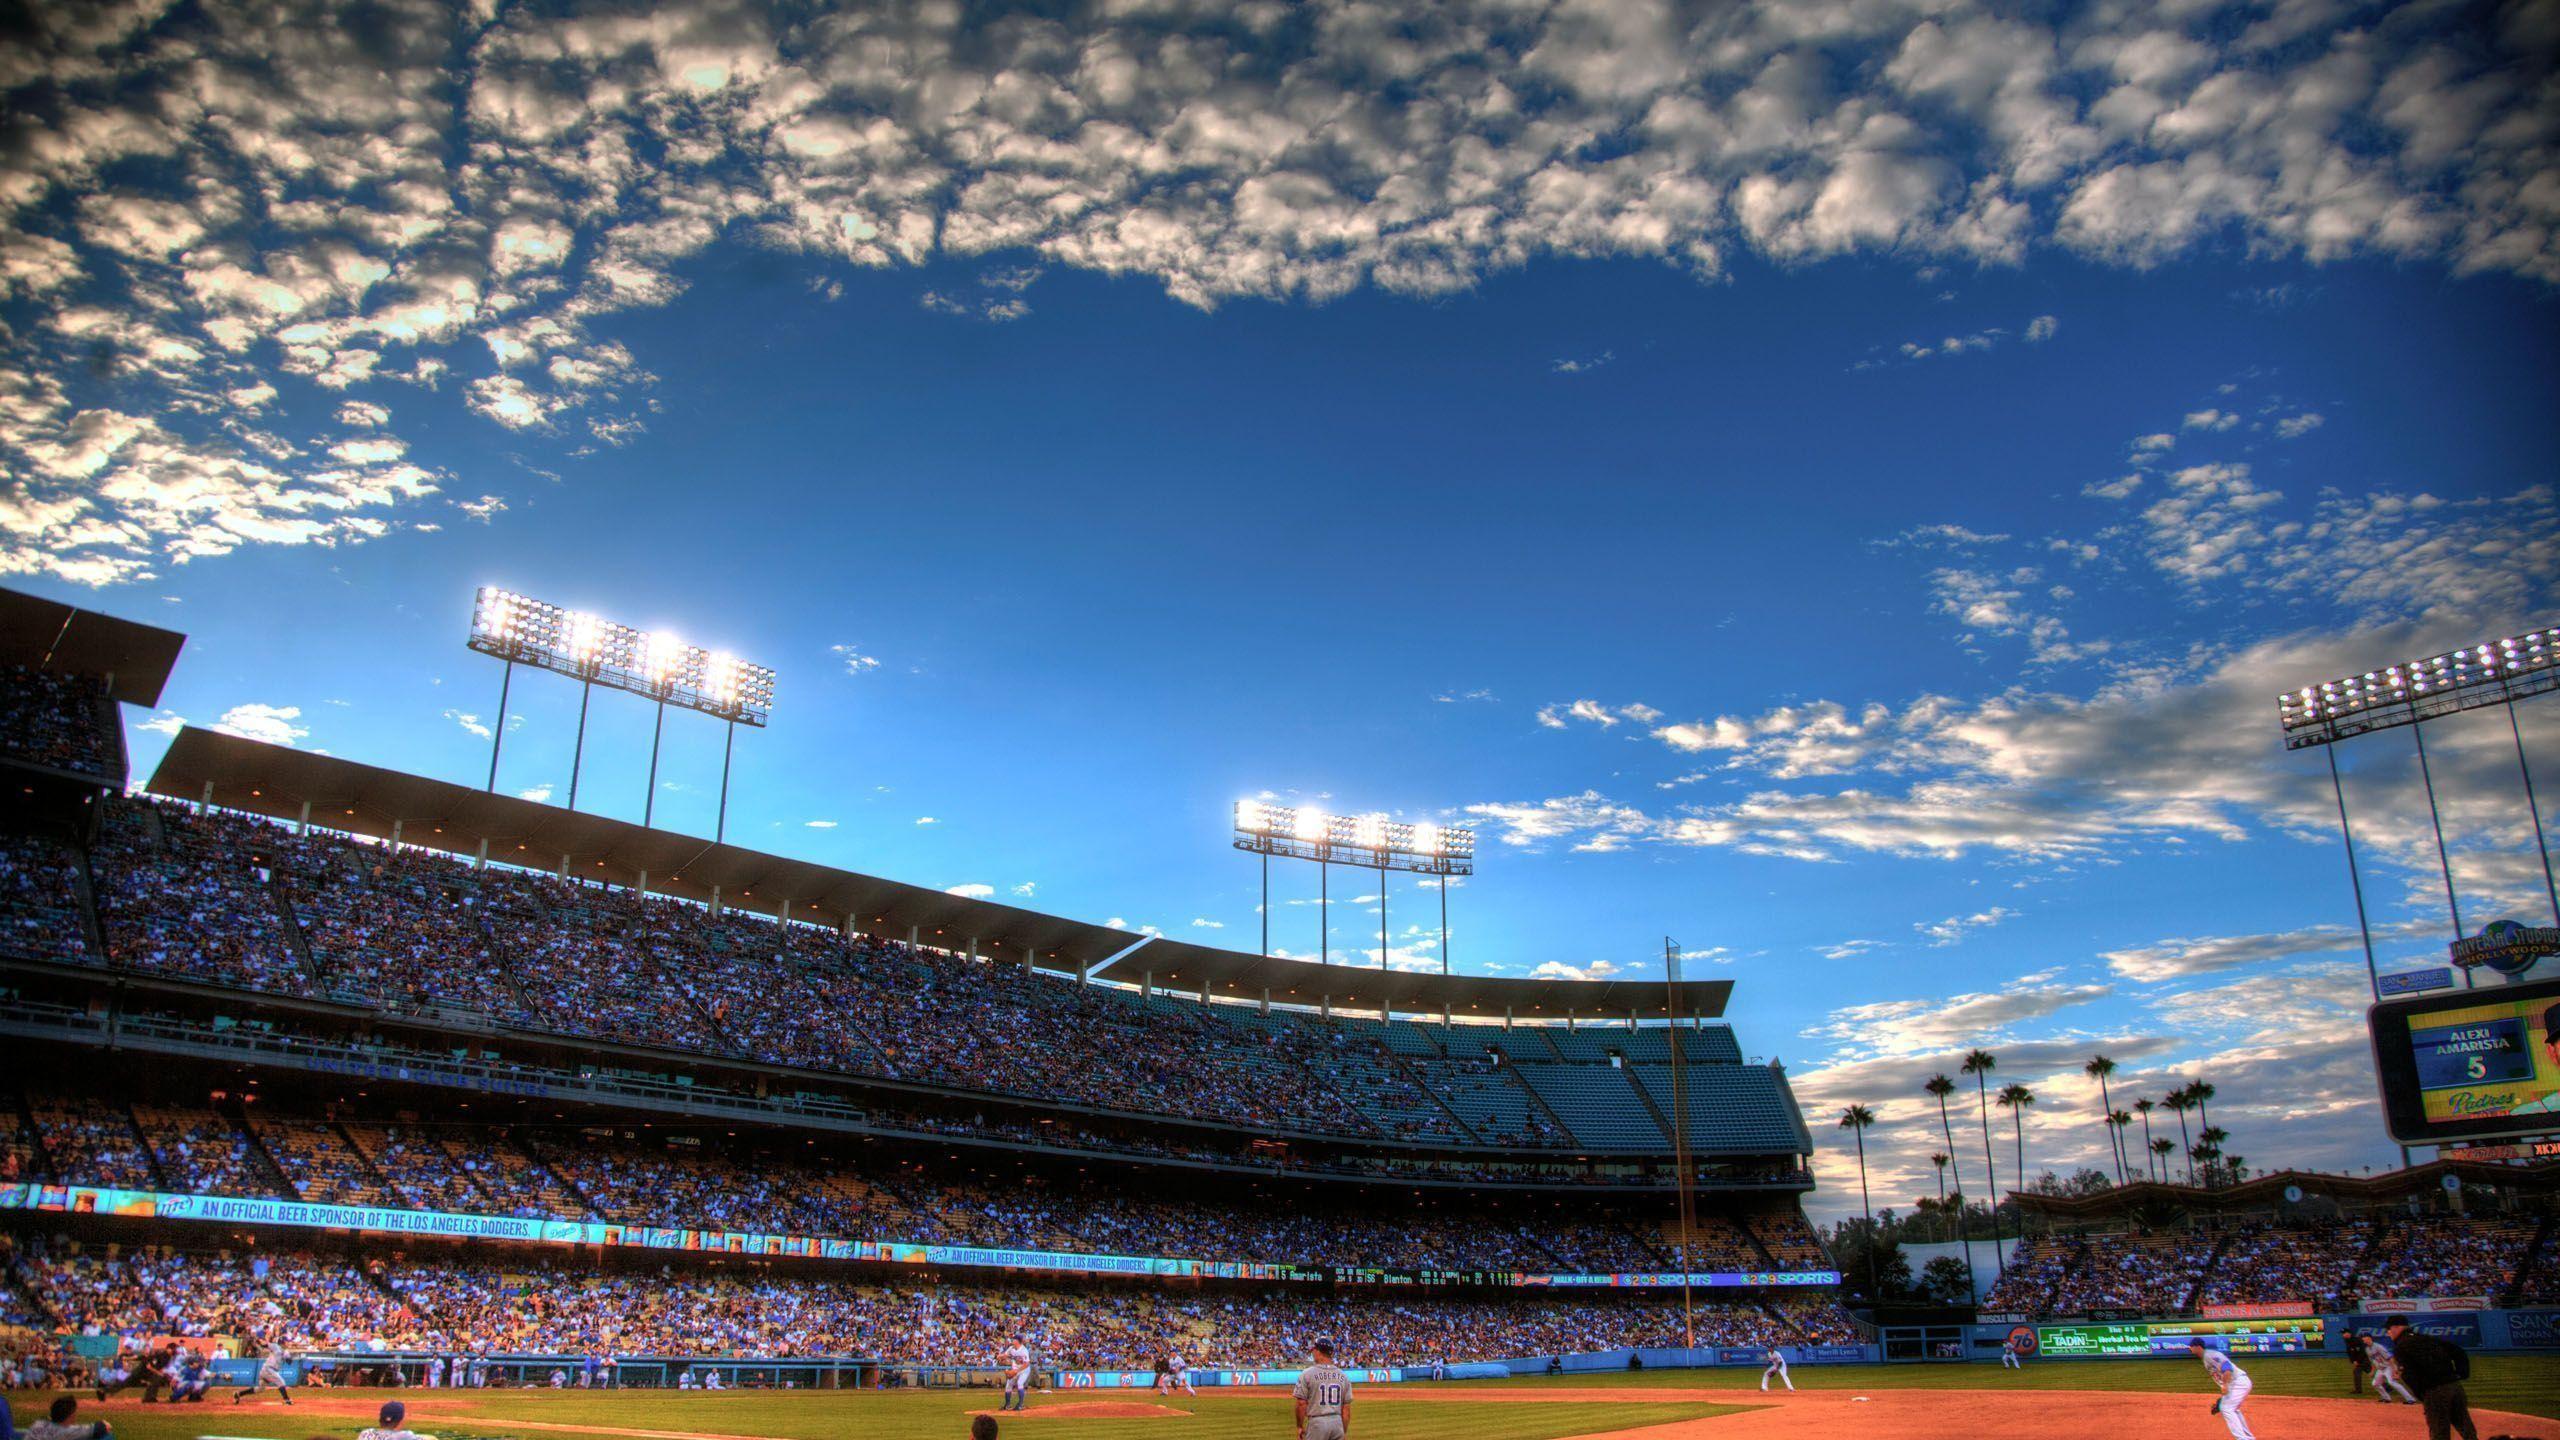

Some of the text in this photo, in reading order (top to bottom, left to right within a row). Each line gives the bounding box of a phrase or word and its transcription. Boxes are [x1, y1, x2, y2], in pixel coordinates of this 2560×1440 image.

[2450, 931, 2511, 961] UNIVERSAL
[2466, 944, 2551, 963] HOLLYWOOD
[2450, 1028, 2490, 1042] ALEXI
[2436, 1037, 2511, 1055] AMARISTA
[2467, 1055, 2487, 1079] 5
[307, 1056, 549, 1096] UNITED CLUB SUITES
[2449, 1091, 2515, 1115] Padres
[201, 1200, 220, 1217] AN
[221, 1202, 275, 1220] OFFICIAL
[277, 1205, 308, 1223] BEER
[310, 1208, 365, 1226] SPONSOR
[367, 1211, 382, 1226] OF
[385, 1213, 407, 1228] THE
[408, 1214, 429, 1231] LOS
[430, 1216, 478, 1234] ANGELES
[952, 1250, 963, 1262] AN
[964, 1251, 995, 1264] OFFICIAL
[996, 1253, 1014, 1265] BEER
[1015, 1254, 1048, 1267] SPONSOR
[1049, 1255, 1058, 1267] OF
[1059, 1256, 1073, 1268] THE
[1073, 1257, 1086, 1269] LOS
[1087, 1258, 1115, 1270] ANGELES
[1290, 1271, 1322, 1281] Amarista
[1384, 1274, 1412, 1284] Blanton
[1658, 1274, 1712, 1285] SPORTS
[1777, 1273, 1833, 1284] SPORTS
[1977, 1313, 2028, 1323] MUSCLE MILK
[2510, 1314, 2549, 1328] SAN
[2013, 1333, 2033, 1348] 76
[2053, 1335, 2086, 1346] TADIN
[2101, 1345, 2116, 1353] Los
[1068, 1373, 1092, 1387] 76
[1314, 1372, 1345, 1383] ROBERTS
[1319, 1384, 1341, 1406] 10
